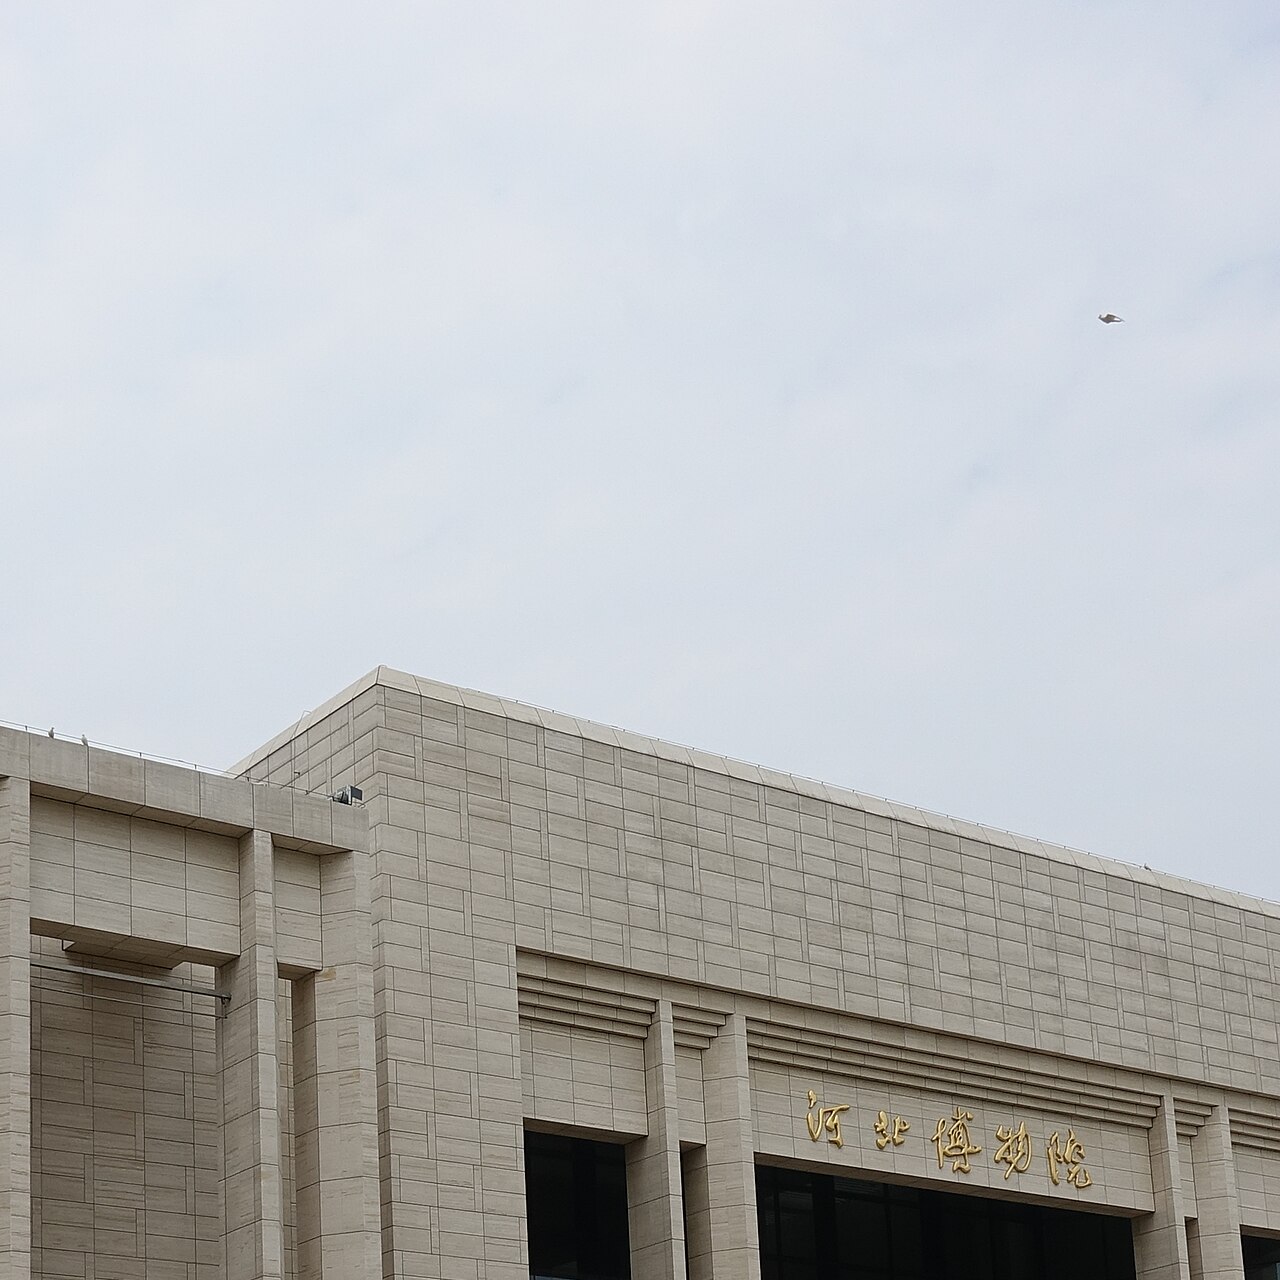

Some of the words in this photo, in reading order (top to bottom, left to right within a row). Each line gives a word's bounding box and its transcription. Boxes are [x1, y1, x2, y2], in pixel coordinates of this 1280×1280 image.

[805, 1089, 1093, 1189] 河北博物院
